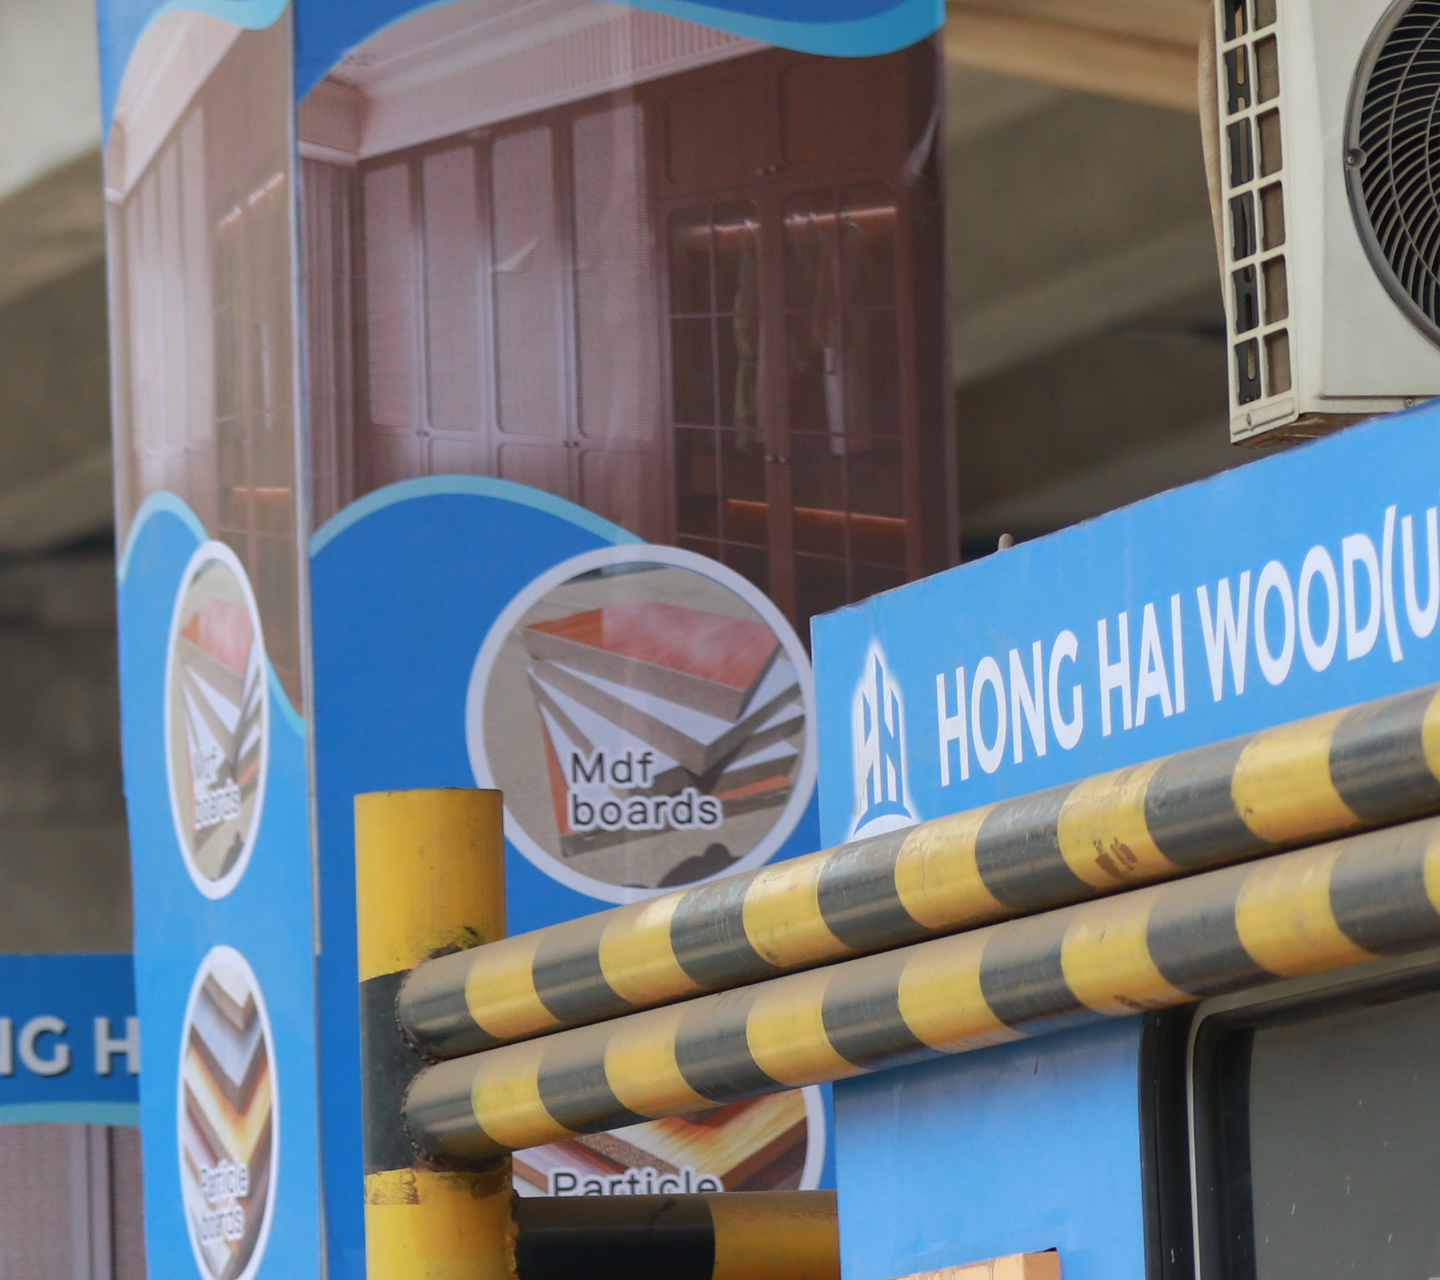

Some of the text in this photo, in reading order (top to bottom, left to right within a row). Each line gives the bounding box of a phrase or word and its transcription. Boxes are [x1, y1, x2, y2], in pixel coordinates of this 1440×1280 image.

[936, 630, 1083, 788] HONG
[1097, 594, 1185, 736] HAI
[571, 752, 655, 785] Mdf
[571, 792, 720, 827] boards
